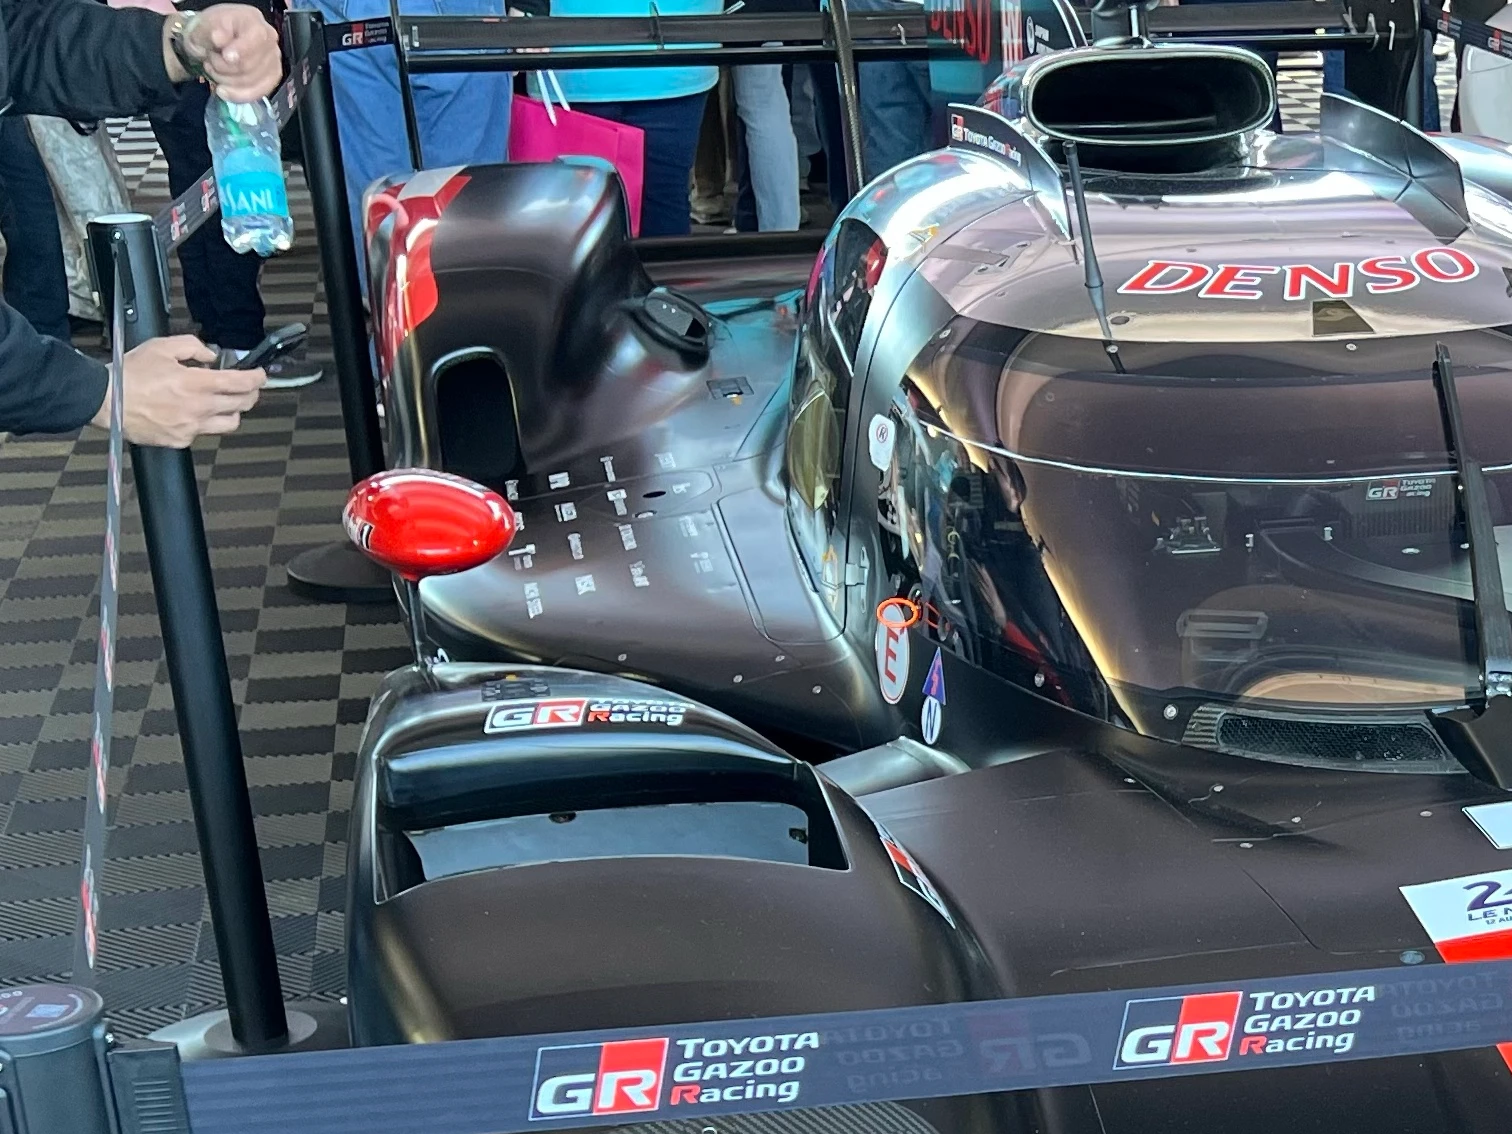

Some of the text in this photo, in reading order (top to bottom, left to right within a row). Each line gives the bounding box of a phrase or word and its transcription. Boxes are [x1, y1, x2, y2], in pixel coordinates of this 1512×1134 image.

[1116, 246, 1480, 300] DENSO
[1368, 487, 1398, 498] GR
[492, 704, 581, 727] GR
[588, 711, 685, 727] Racing
[1467, 909, 1497, 921] LE
[1250, 986, 1375, 1011] TOYOTA
[1243, 1009, 1361, 1034] GAZOO
[676, 1032, 820, 1059] TOYOTA
[1121, 1021, 1230, 1063] GR
[1239, 1031, 1355, 1056] Racing
[673, 1056, 805, 1082] GAZOO
[536, 1070, 658, 1113] GR
[671, 1080, 800, 1105] Racing
